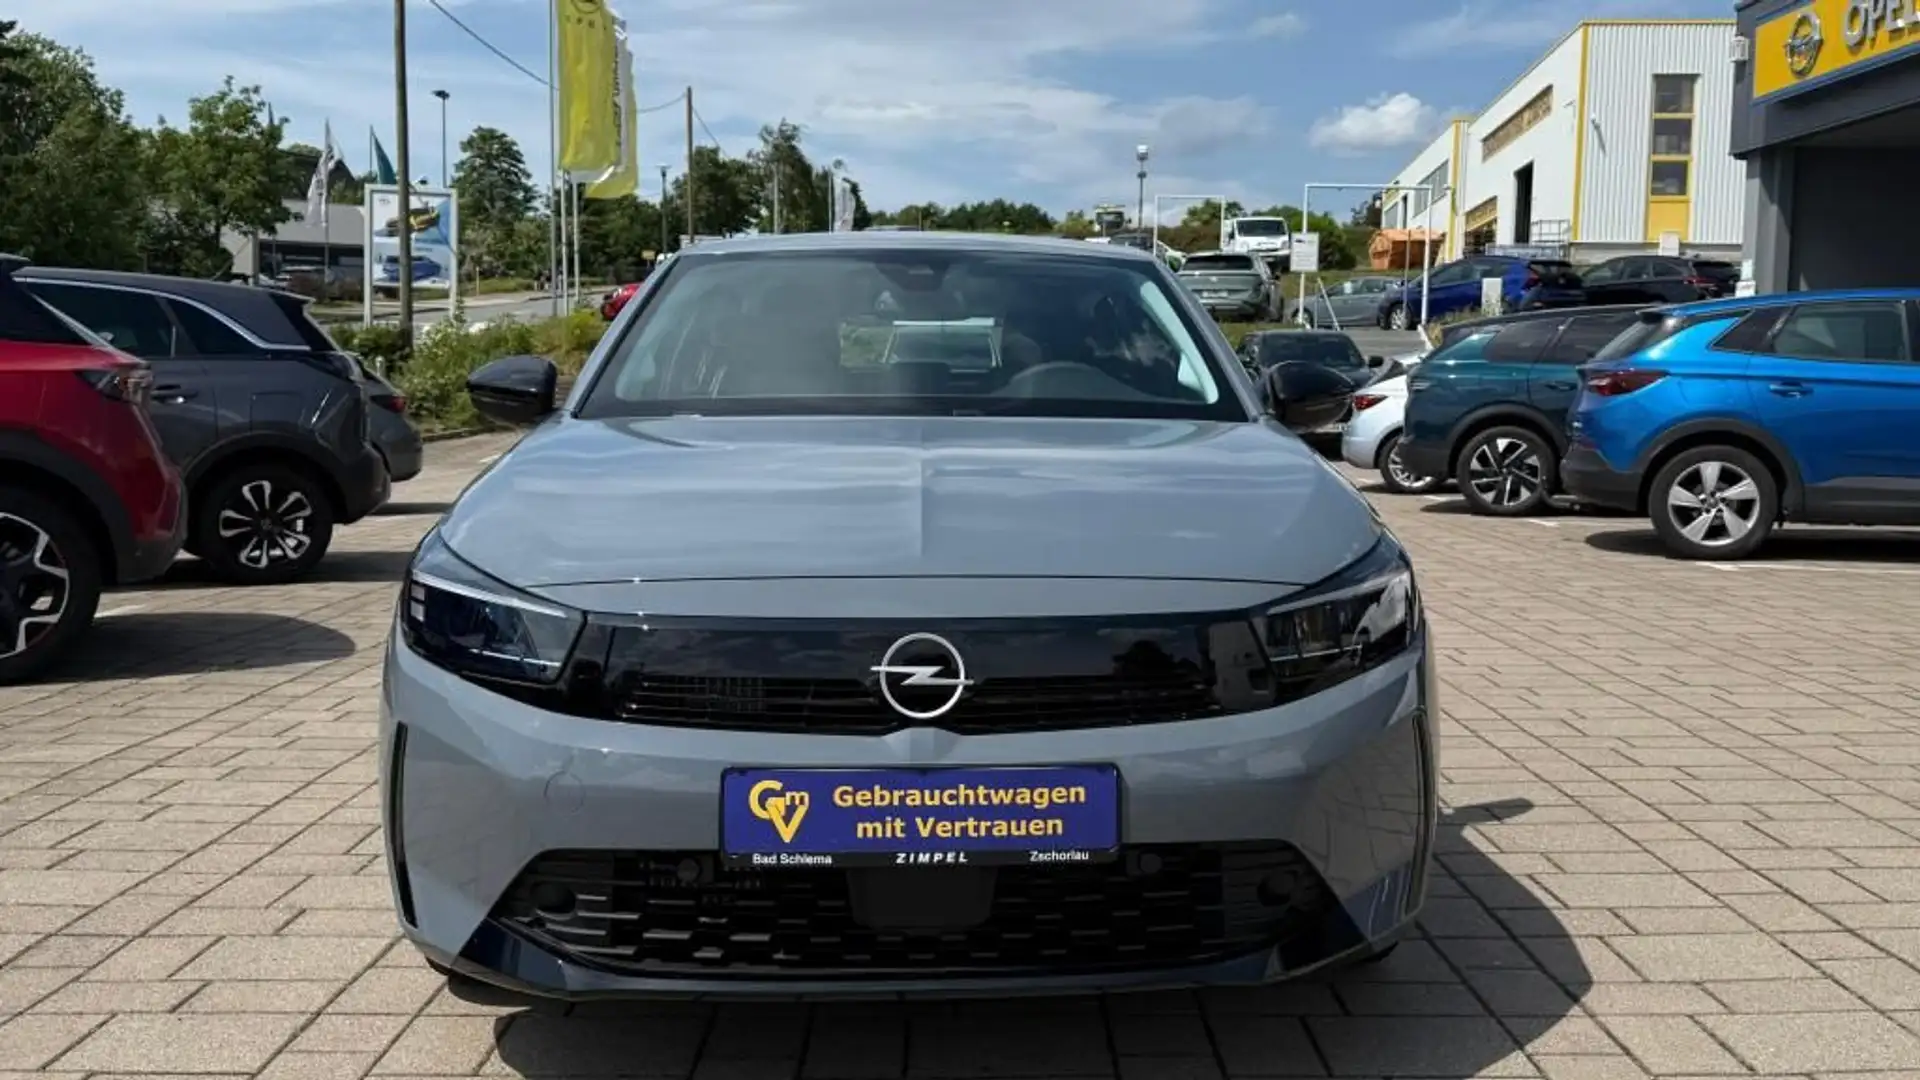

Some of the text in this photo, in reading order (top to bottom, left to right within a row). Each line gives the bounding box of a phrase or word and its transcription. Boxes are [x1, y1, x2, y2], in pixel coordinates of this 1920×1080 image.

[832, 784, 1087, 809] Gebrauchtwagen
[856, 816, 1064, 839] mit Vertrauen
[752, 853, 777, 865] Bad
[896, 851, 969, 864] ZIMPEL
